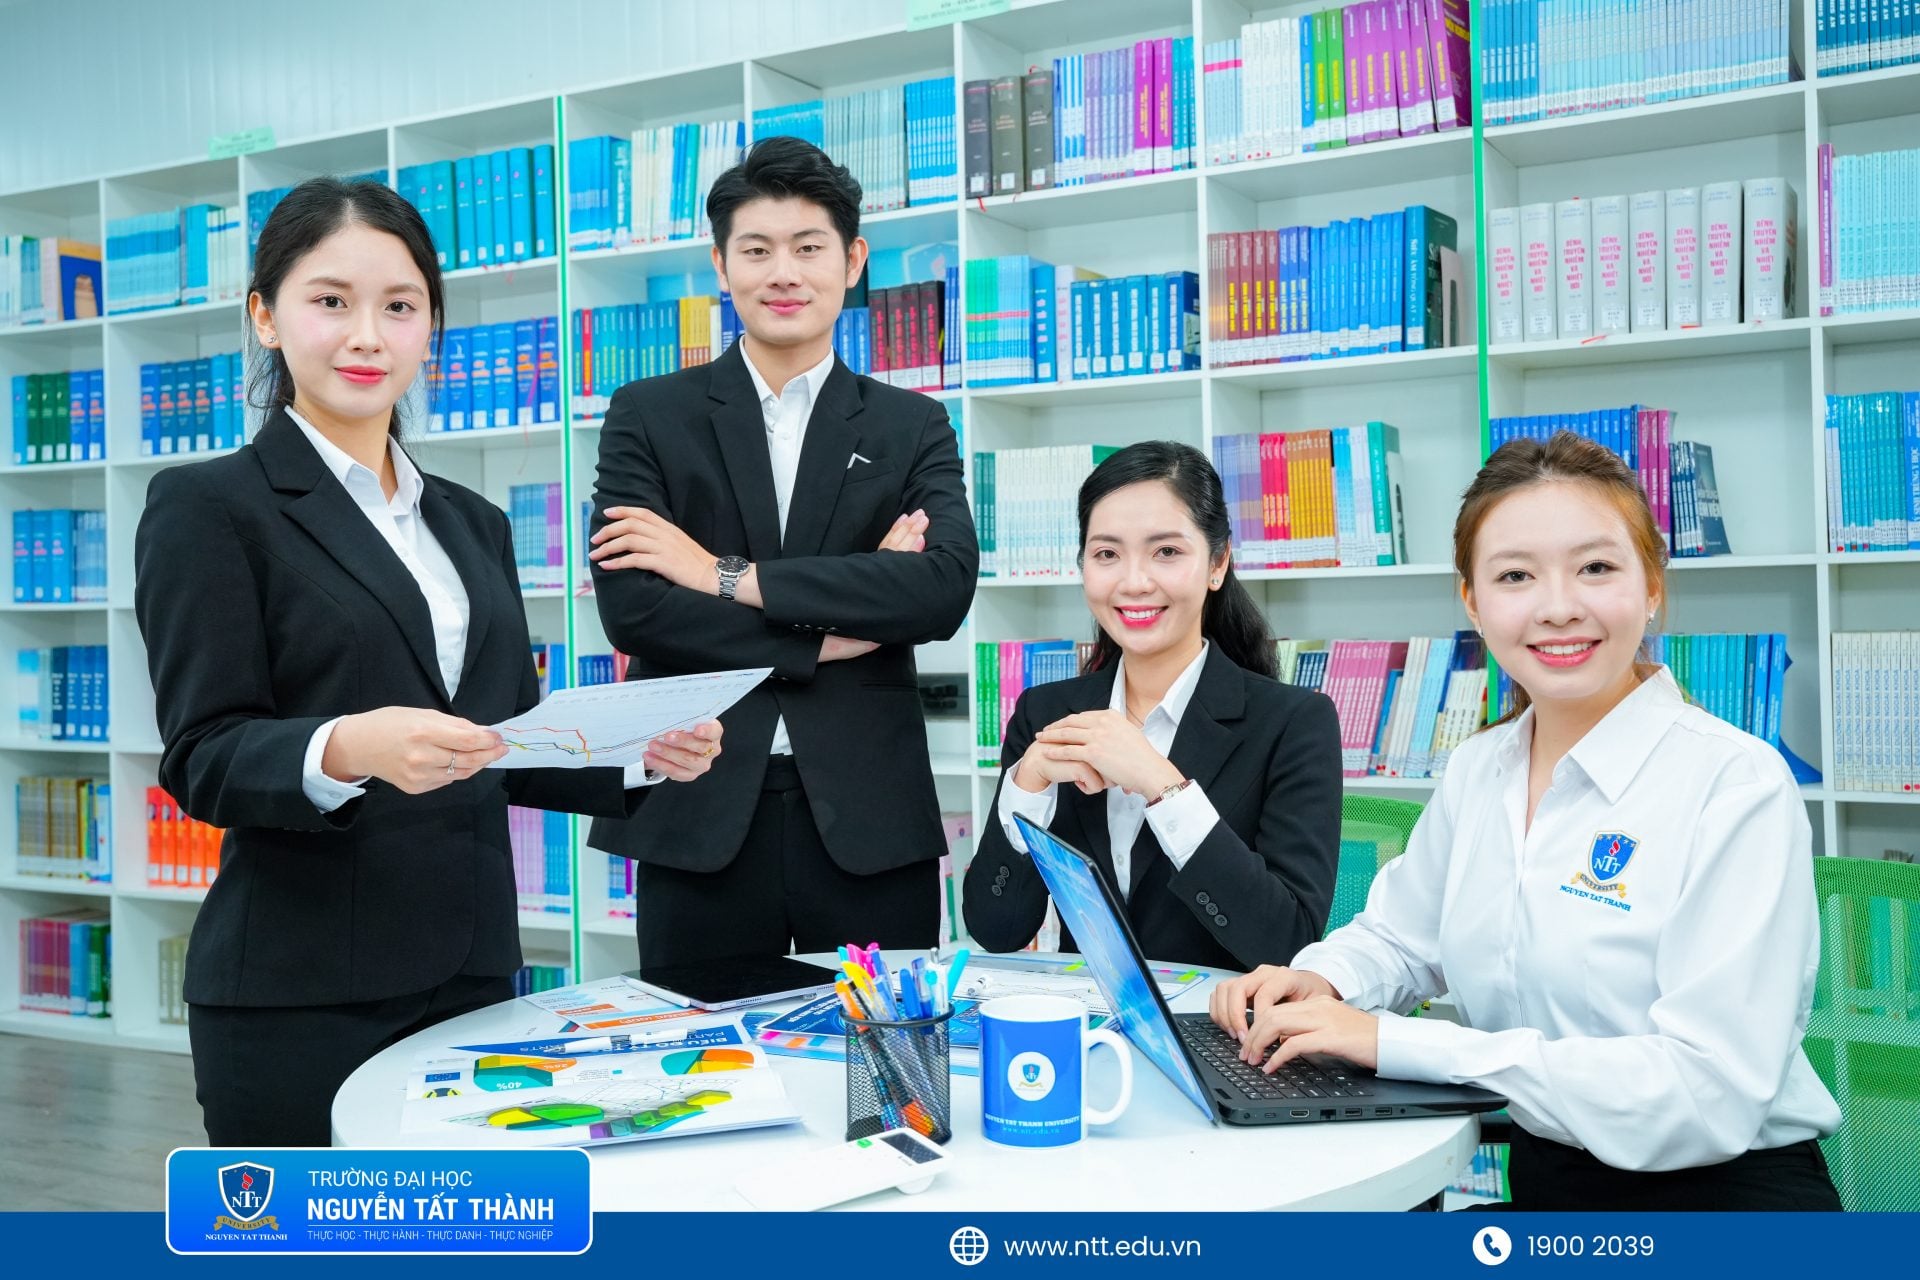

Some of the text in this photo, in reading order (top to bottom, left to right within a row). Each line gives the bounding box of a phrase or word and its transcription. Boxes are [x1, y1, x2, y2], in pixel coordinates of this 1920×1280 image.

[1593, 855, 1621, 874] NTT
[1560, 885, 1632, 912] NGUYEN TAT THANH
[496, 1081, 523, 1090] 40%
